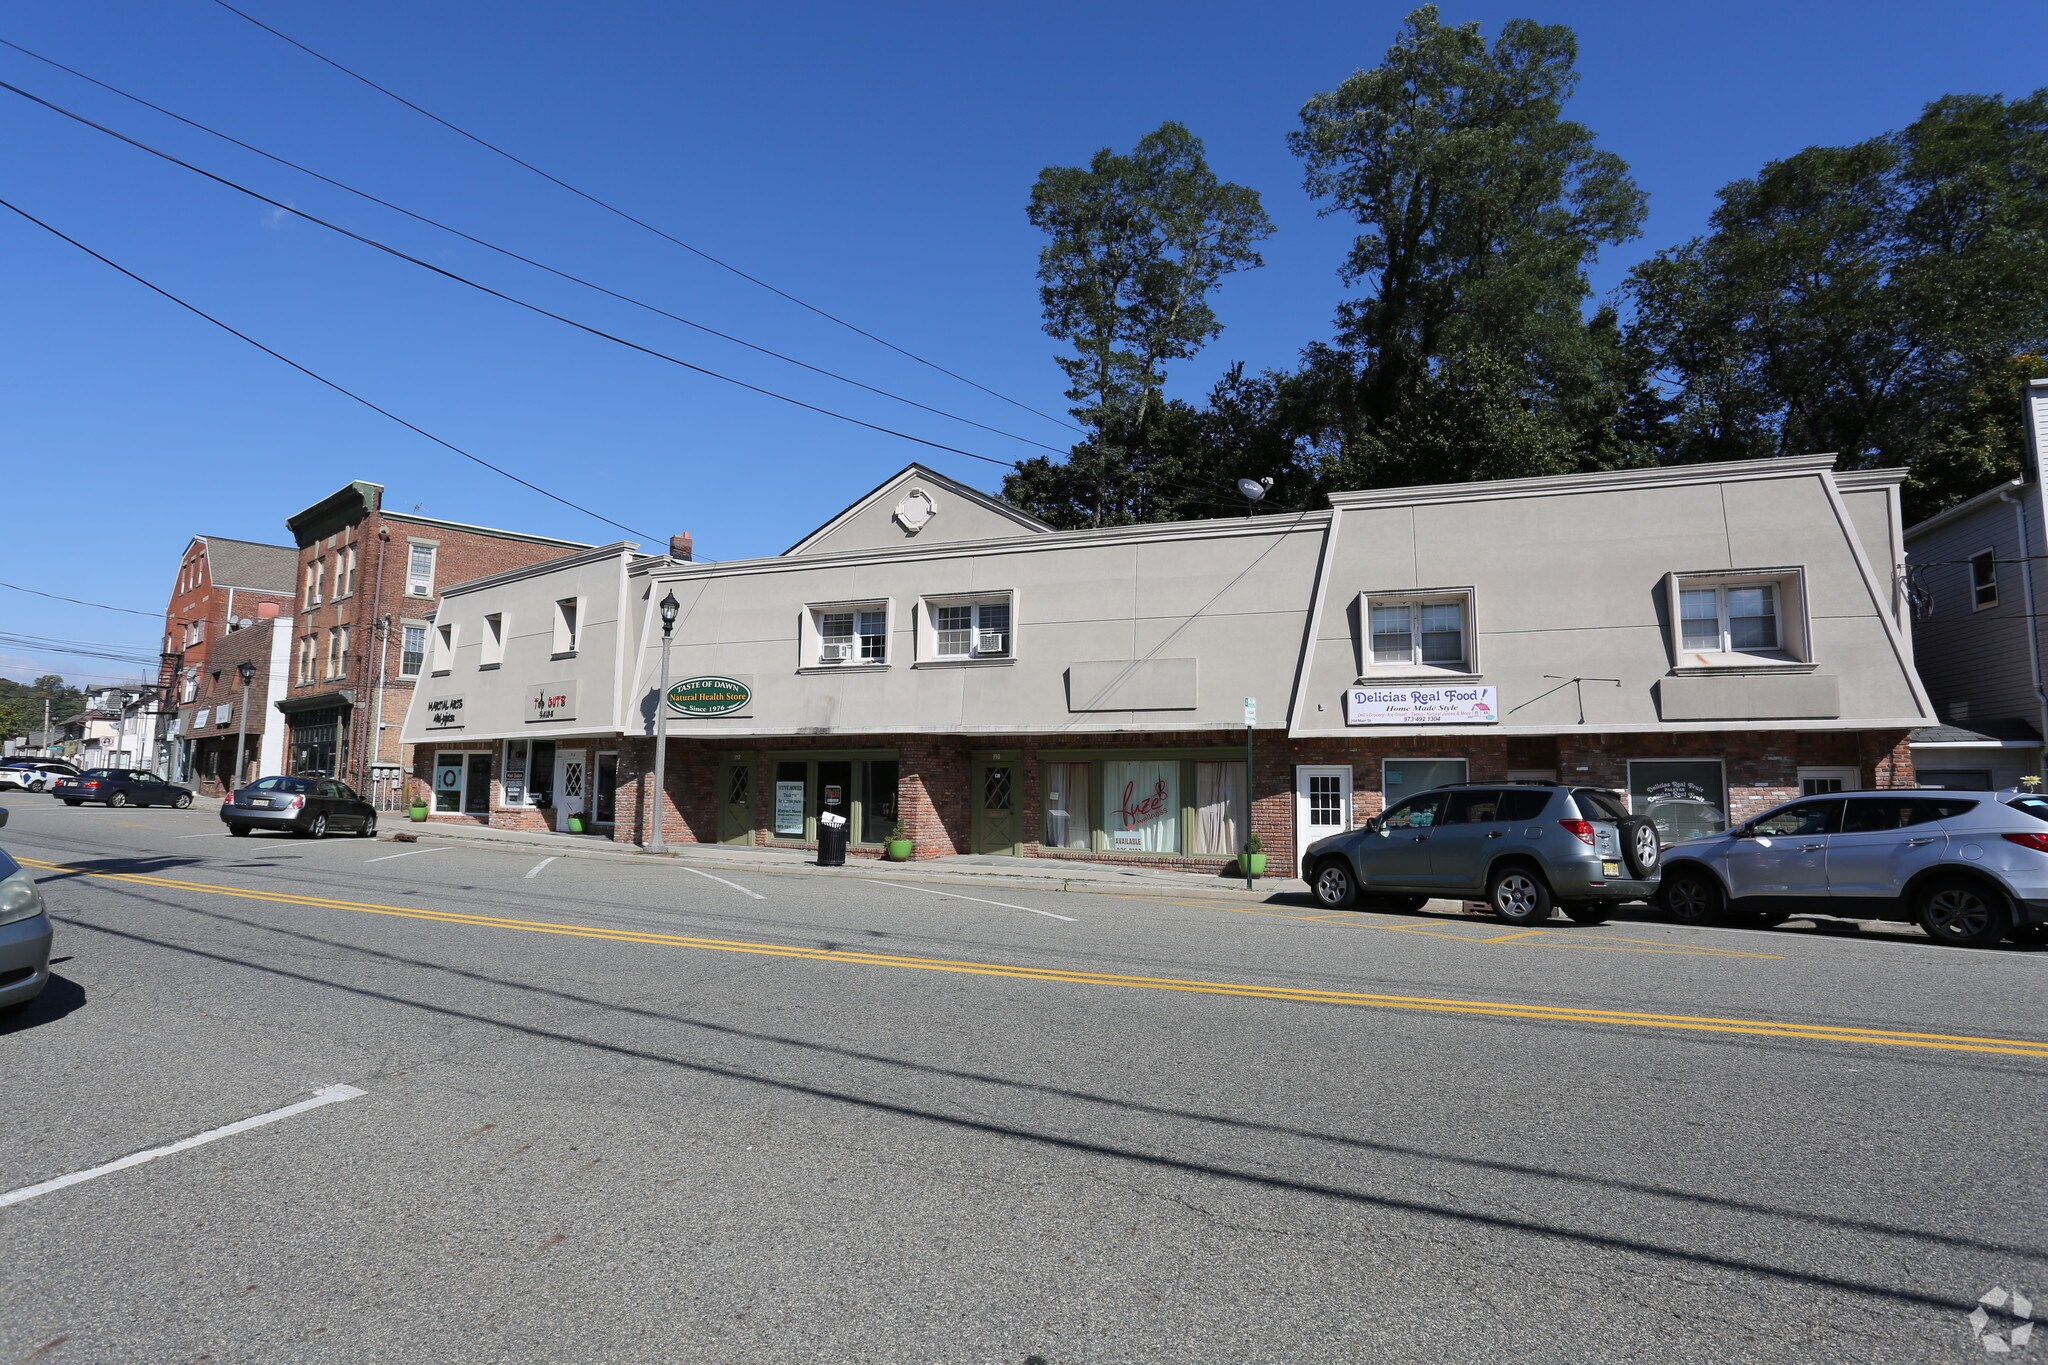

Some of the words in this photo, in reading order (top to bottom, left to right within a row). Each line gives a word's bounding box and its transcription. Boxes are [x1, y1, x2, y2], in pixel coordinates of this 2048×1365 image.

[677, 681, 700, 693] TASTE
[702, 680, 712, 688] OF
[714, 681, 739, 692] DAWN
[670, 693, 697, 702] Natural
[699, 693, 724, 701] Health
[726, 692, 746, 700] Store
[1355, 691, 1407, 704] Delicias
[1410, 690, 1440, 705] Real
[1438, 704, 1458, 712] Style
[1647, 782, 1671, 793] Delicias
[1688, 783, 1704, 793] Fruit
[1647, 792, 1671, 803] Delicias
[1688, 793, 1705, 802] Fruit
[1137, 807, 1168, 824] wellness
